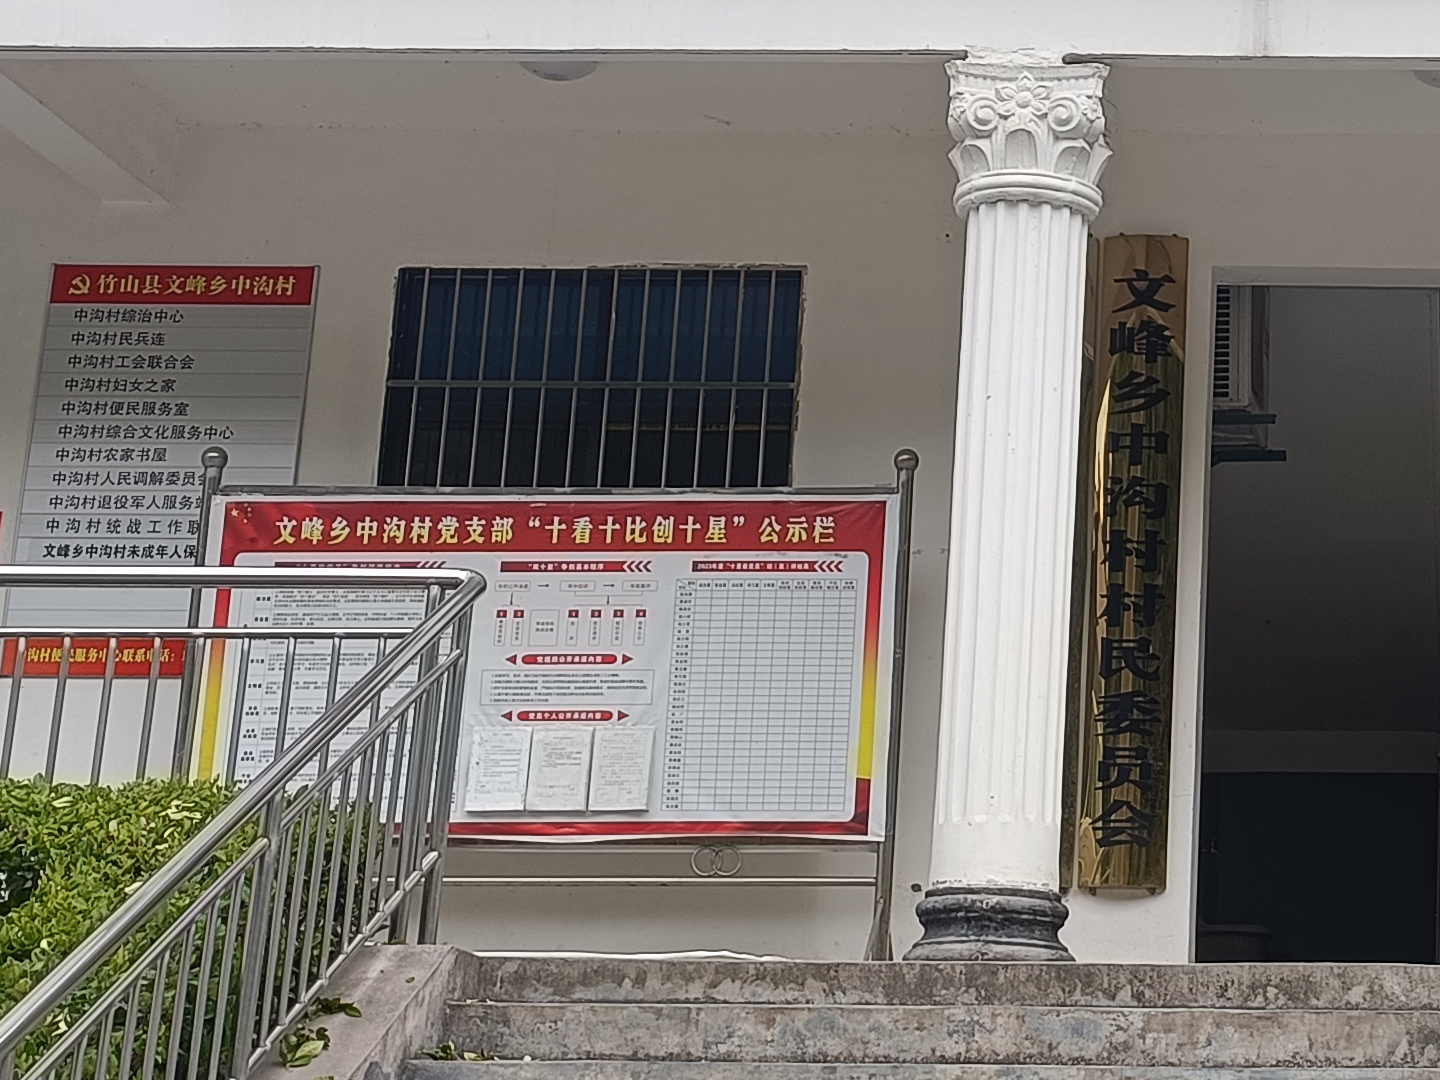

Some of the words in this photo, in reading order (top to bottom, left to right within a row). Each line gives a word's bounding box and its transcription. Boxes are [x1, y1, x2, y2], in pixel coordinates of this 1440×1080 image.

[97, 273, 297, 297] 竹山县文峰乡中沟村
[74, 308, 185, 324] 中沟村综治中心
[71, 331, 166, 347] 中沟村民兵连
[67, 354, 195, 370] 中沟村工会联合会
[64, 377, 176, 393] 中沟村妇女之家
[61, 401, 190, 417] 中沟村便民服务室
[58, 424, 235, 440] 中沟村综合文化服务中心
[55, 447, 167, 463] 中沟村农家书屋
[1090, 268, 1177, 849] 文峰乡中沟村村民委员会
